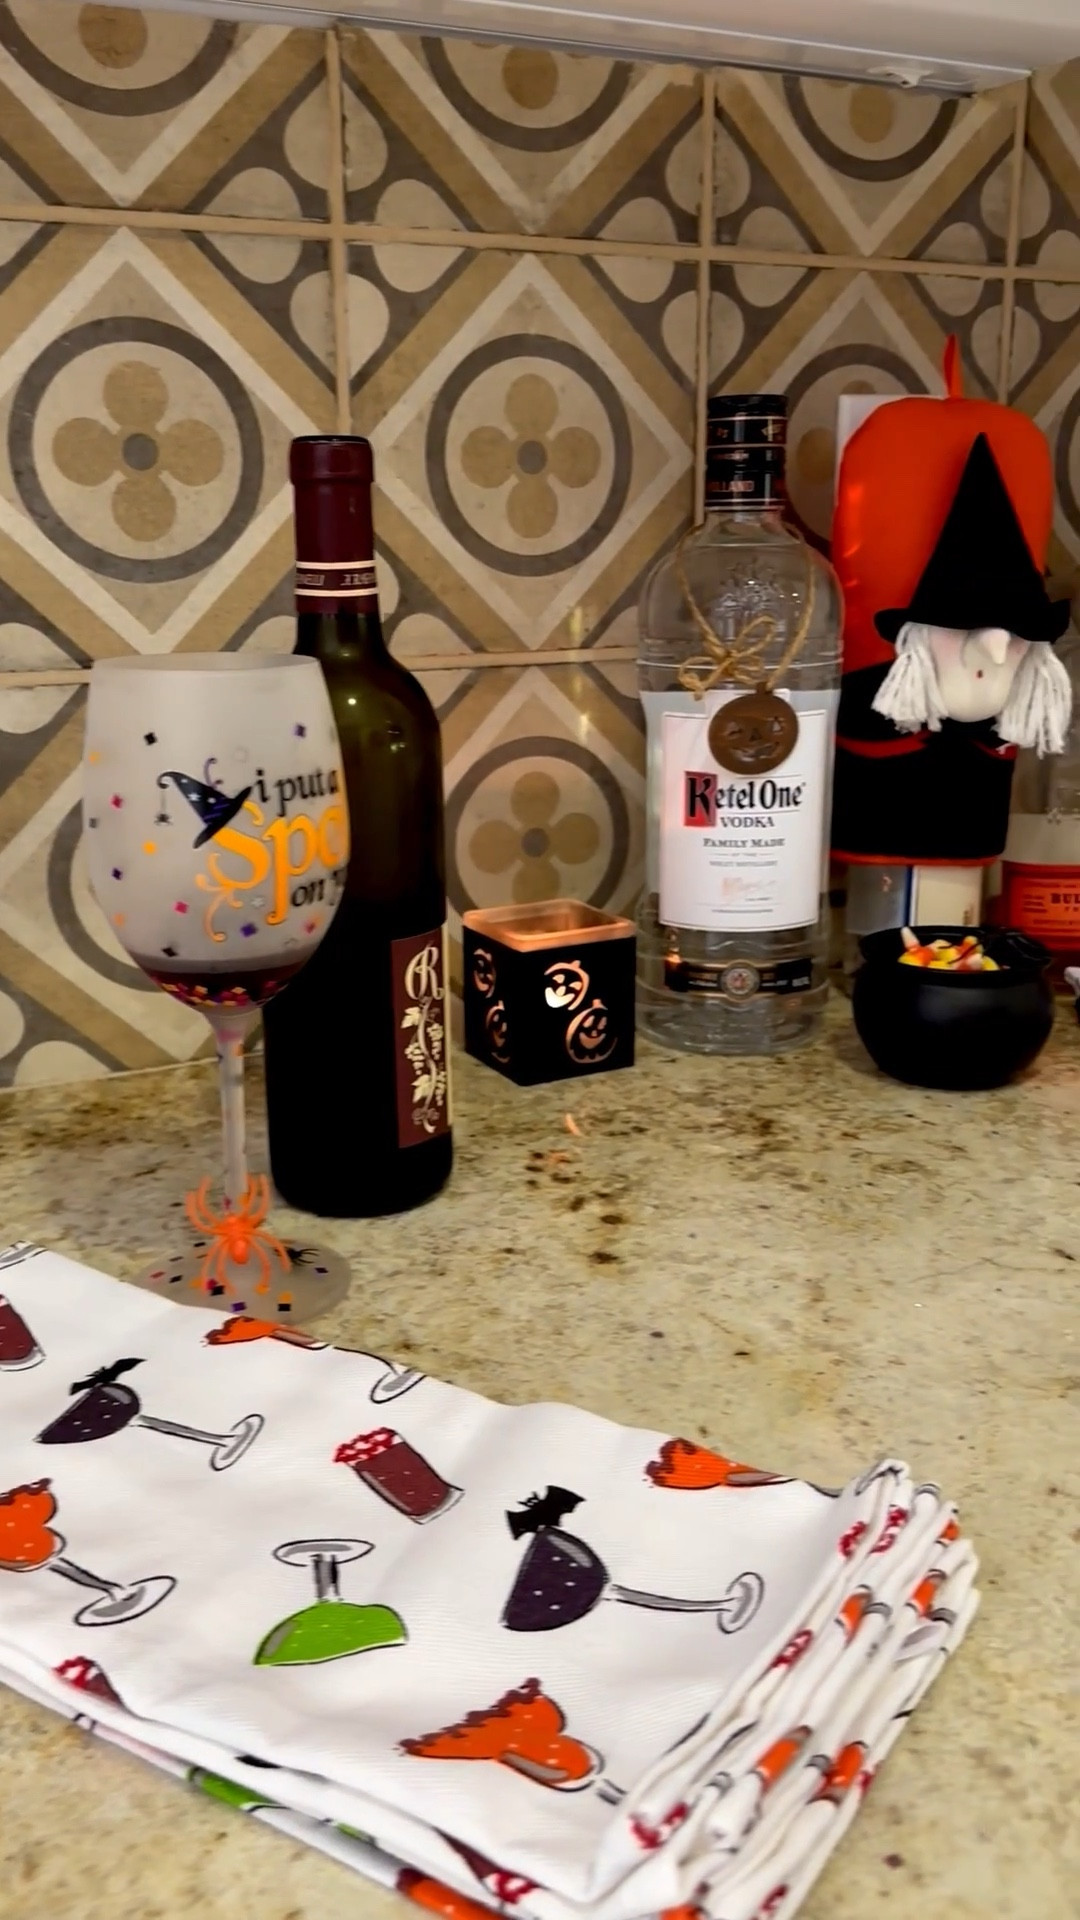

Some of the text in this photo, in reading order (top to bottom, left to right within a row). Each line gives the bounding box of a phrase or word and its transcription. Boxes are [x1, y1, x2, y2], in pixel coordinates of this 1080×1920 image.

[255, 769, 270, 803] i
[274, 771, 325, 818] put
[688, 777, 802, 822] Ketel One
[720, 816, 775, 828] VODKA
[703, 837, 785, 848] FAMILY MADE
[291, 878, 325, 907] on
